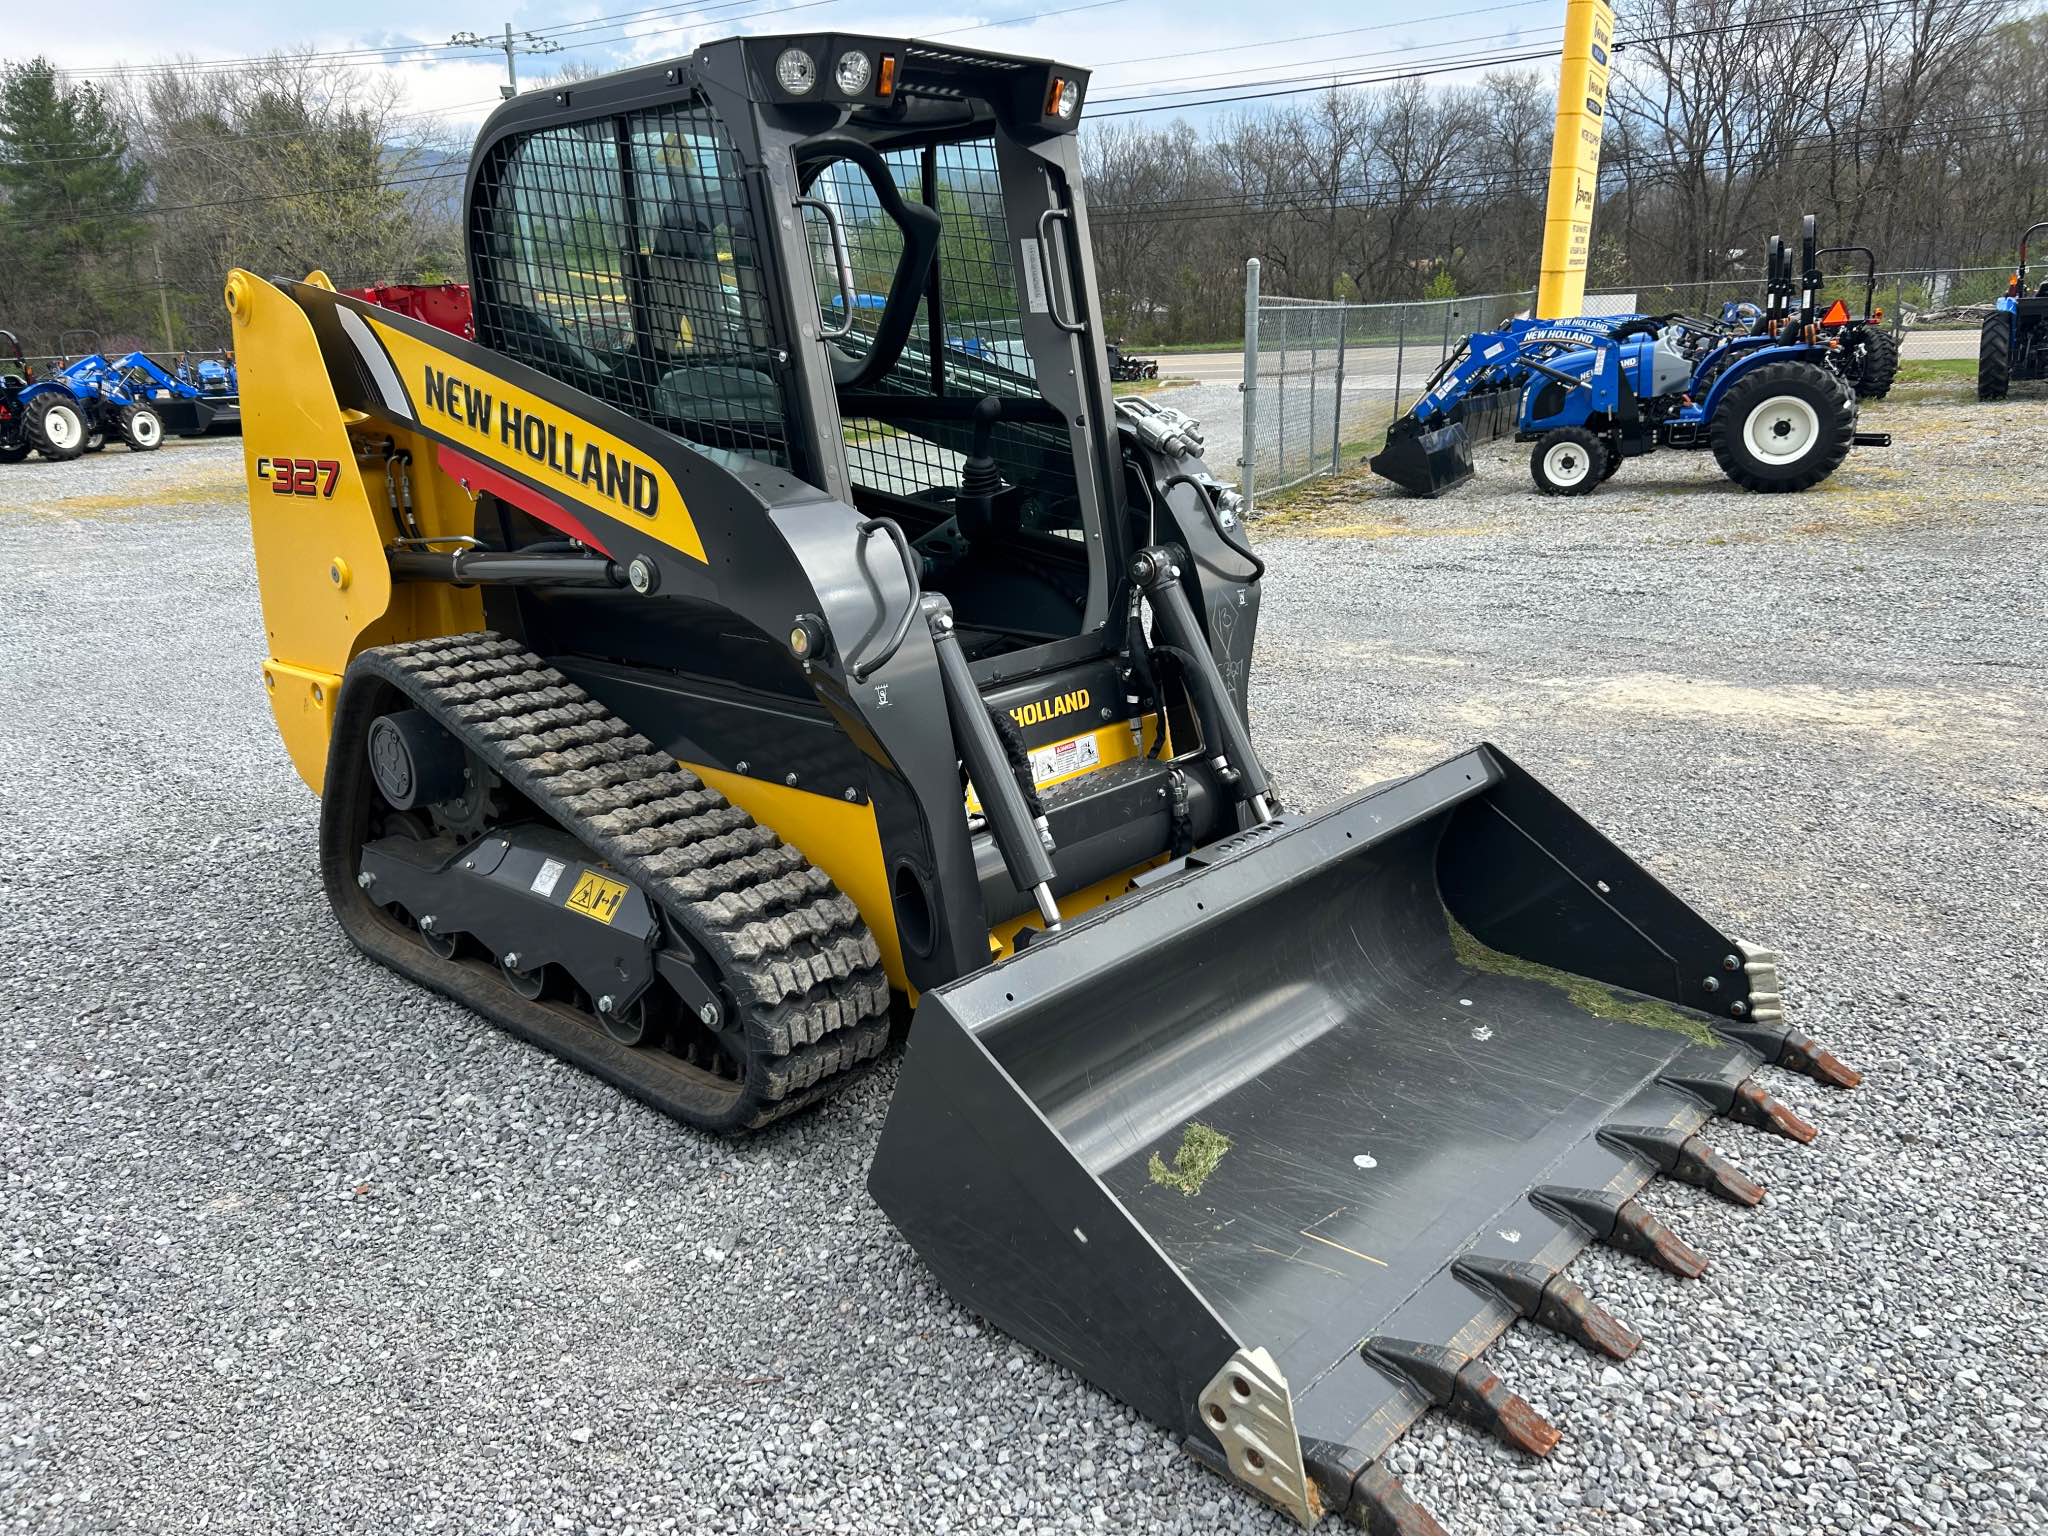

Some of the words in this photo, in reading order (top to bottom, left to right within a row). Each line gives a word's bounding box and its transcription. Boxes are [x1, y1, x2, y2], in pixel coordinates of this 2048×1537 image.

[1553, 319, 1572, 328] NEW
[1524, 330, 1546, 341] NEW
[1546, 329, 1594, 344] HOLLAND
[424, 364, 492, 437] NEW
[500, 400, 660, 518] HOLLAND
